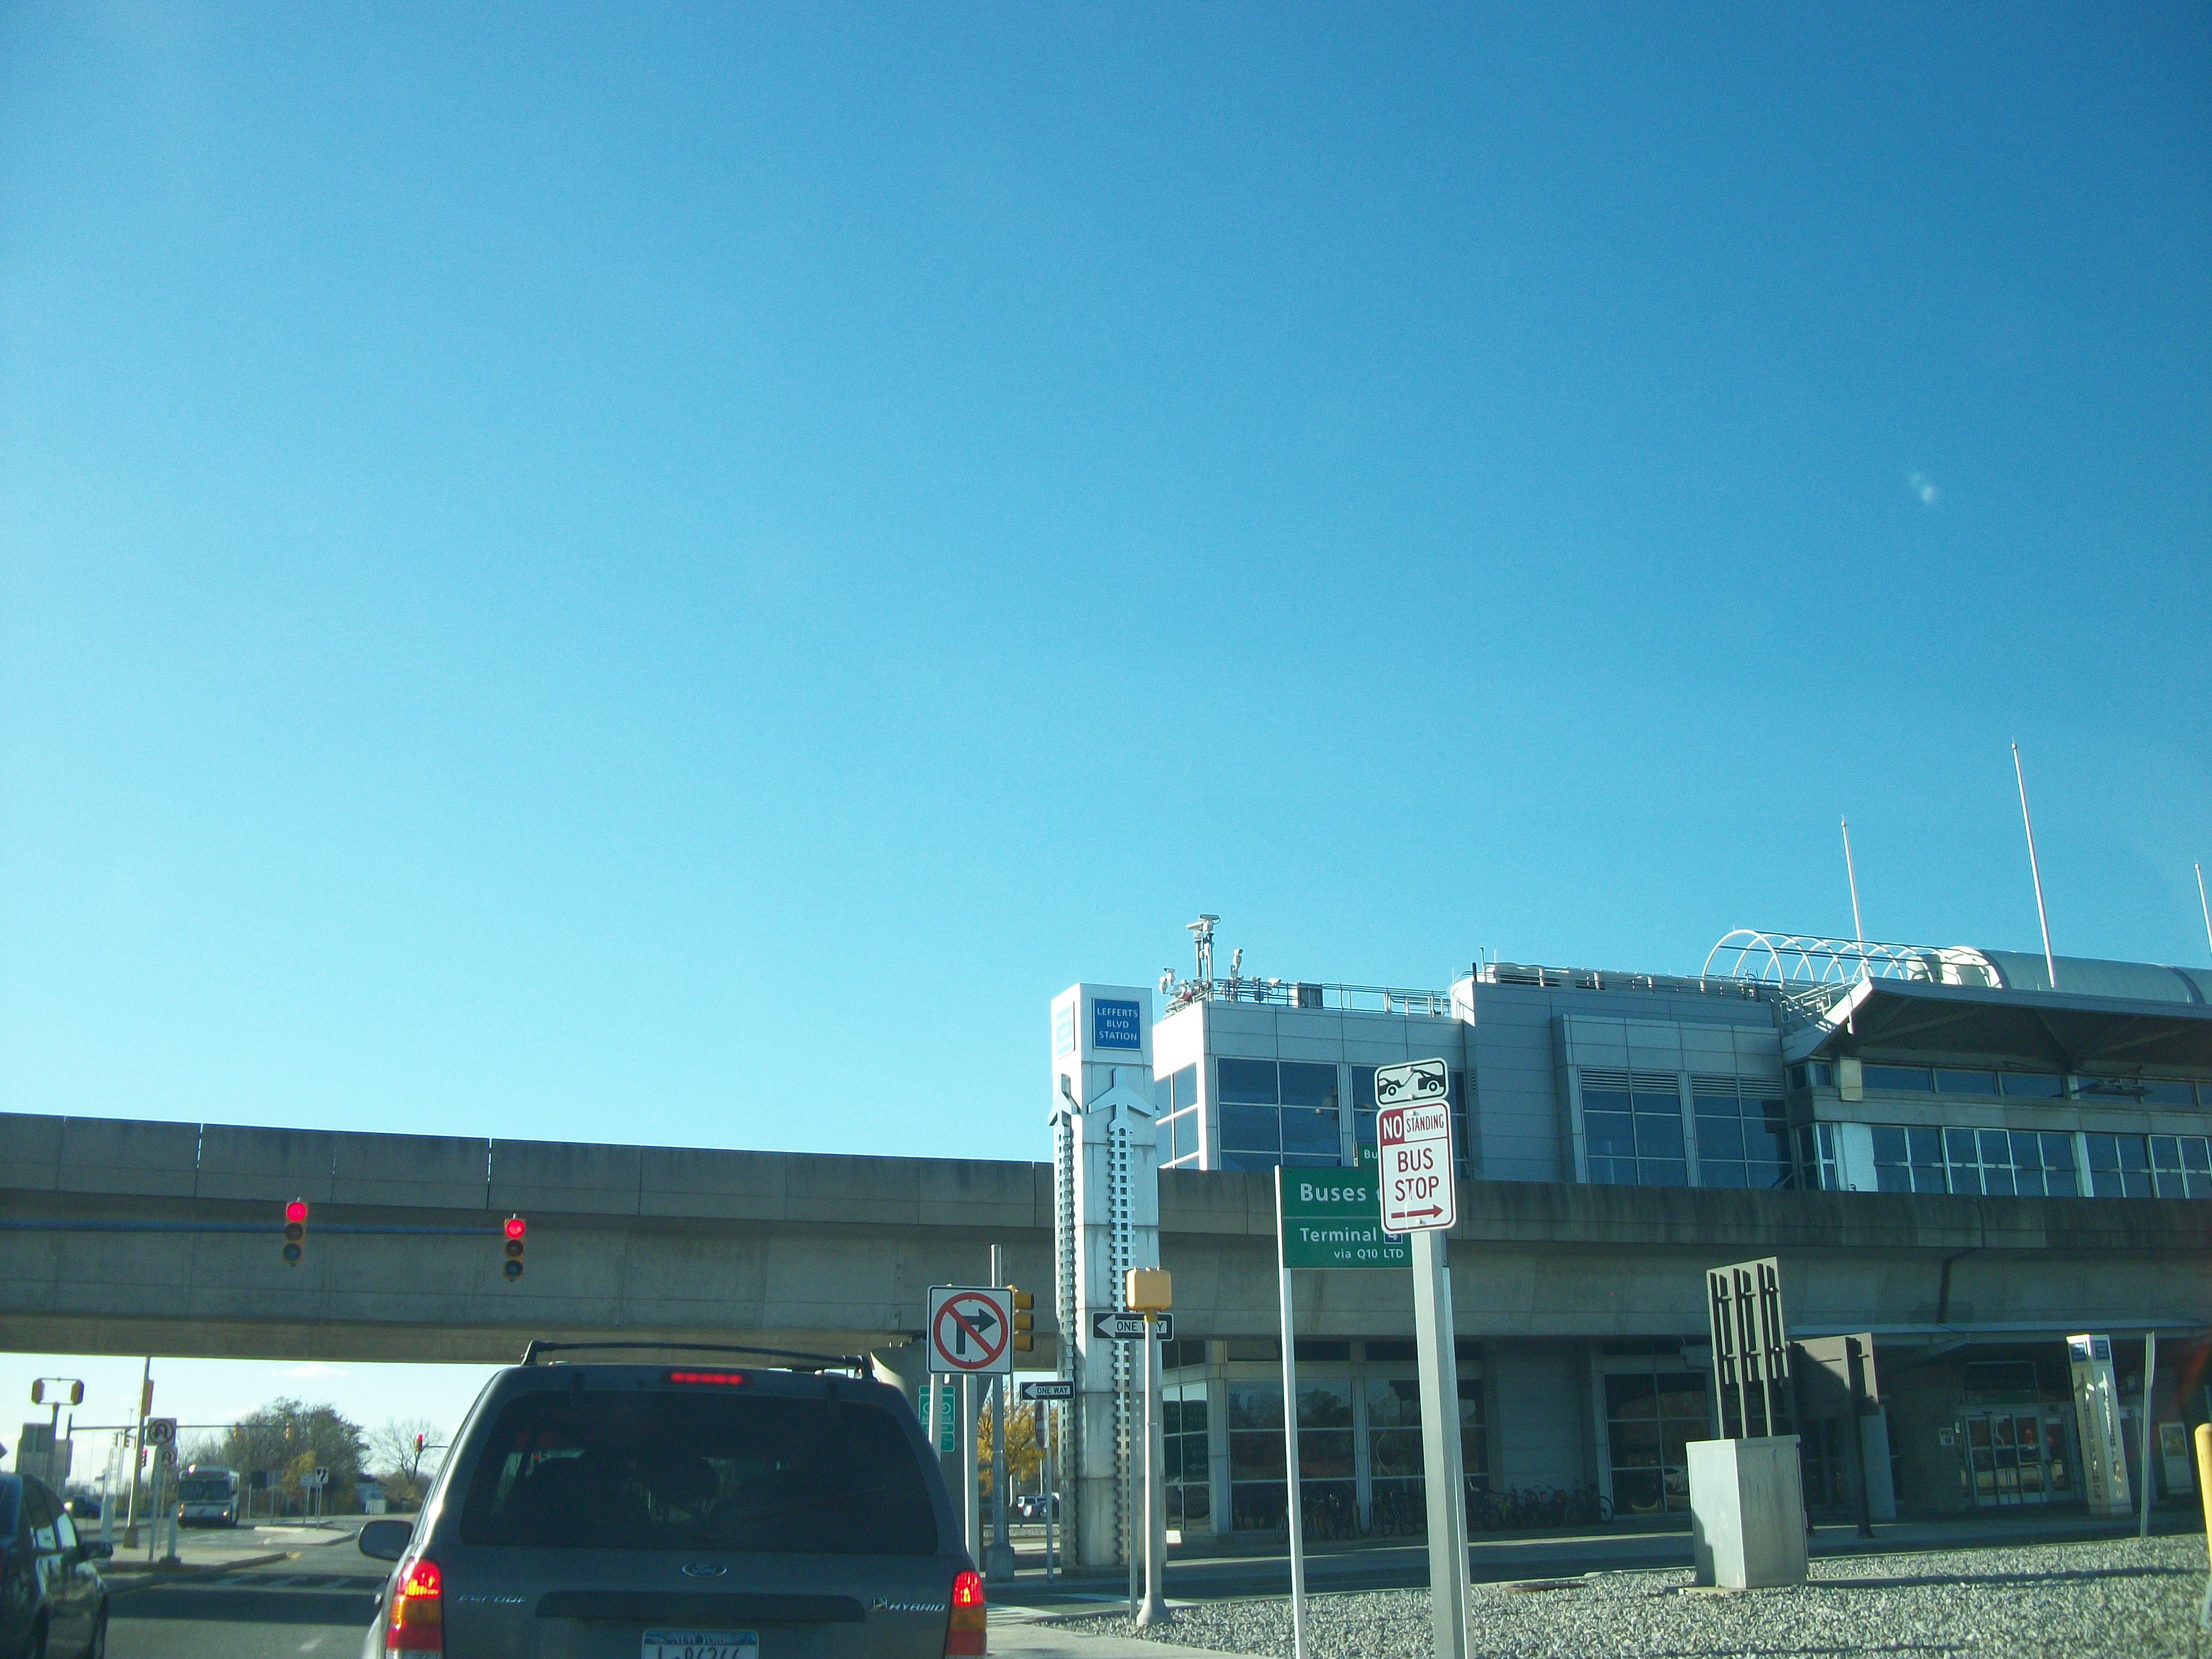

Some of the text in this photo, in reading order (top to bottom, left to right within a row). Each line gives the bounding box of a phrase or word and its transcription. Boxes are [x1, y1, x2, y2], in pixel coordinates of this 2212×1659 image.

[1097, 1008, 1138, 1017] LEFFERTS
[1107, 1020, 1129, 1028] BLVD
[1099, 1031, 1137, 1040] STATION
[1383, 1113, 1444, 1140] NO STANDING
[1397, 1147, 1434, 1173] BUS
[1300, 1183, 1367, 1202] Buses
[1395, 1175, 1439, 1202] STOP
[1300, 1227, 1377, 1242] Terminal
[1334, 1248, 1404, 1260] via Q10 LTD
[1117, 1321, 1138, 1332] ONE
[692, 1564, 717, 1574] Ford
[889, 1603, 946, 1612] HYBRID
[671, 1633, 697, 1645] NEW
